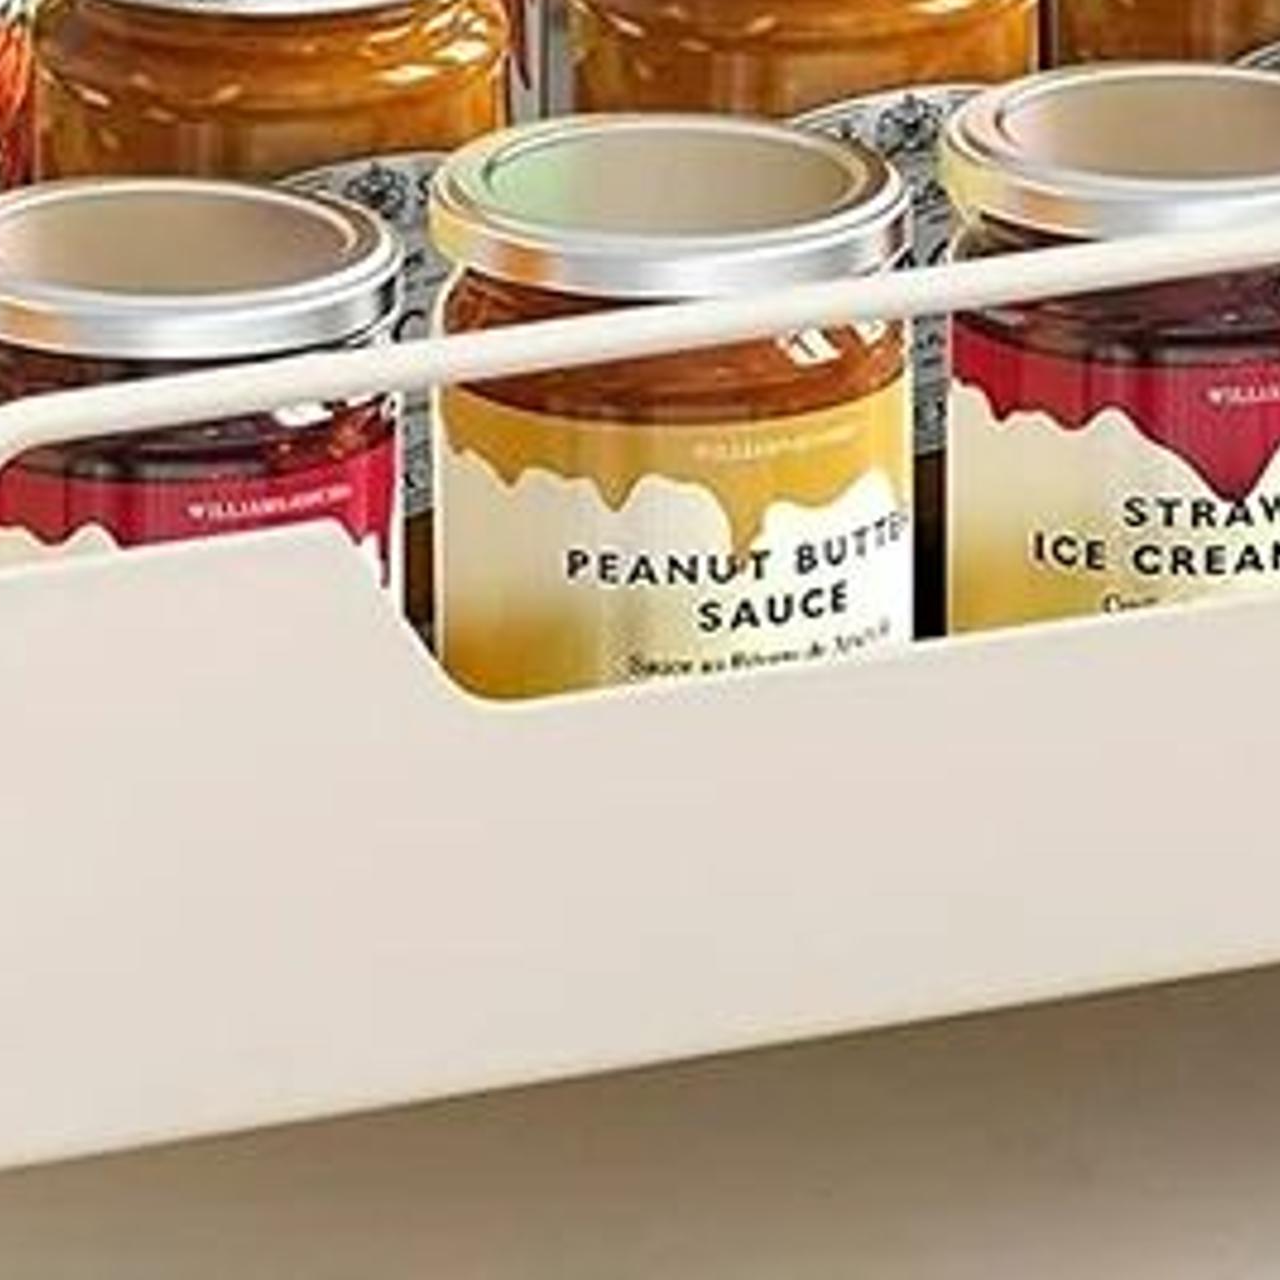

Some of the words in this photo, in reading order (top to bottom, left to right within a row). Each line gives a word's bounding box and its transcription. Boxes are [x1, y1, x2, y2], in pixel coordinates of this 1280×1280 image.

[566, 548, 772, 586] PEANUT
[1032, 532, 1105, 571] ICE
[698, 580, 849, 633] SAUCE
